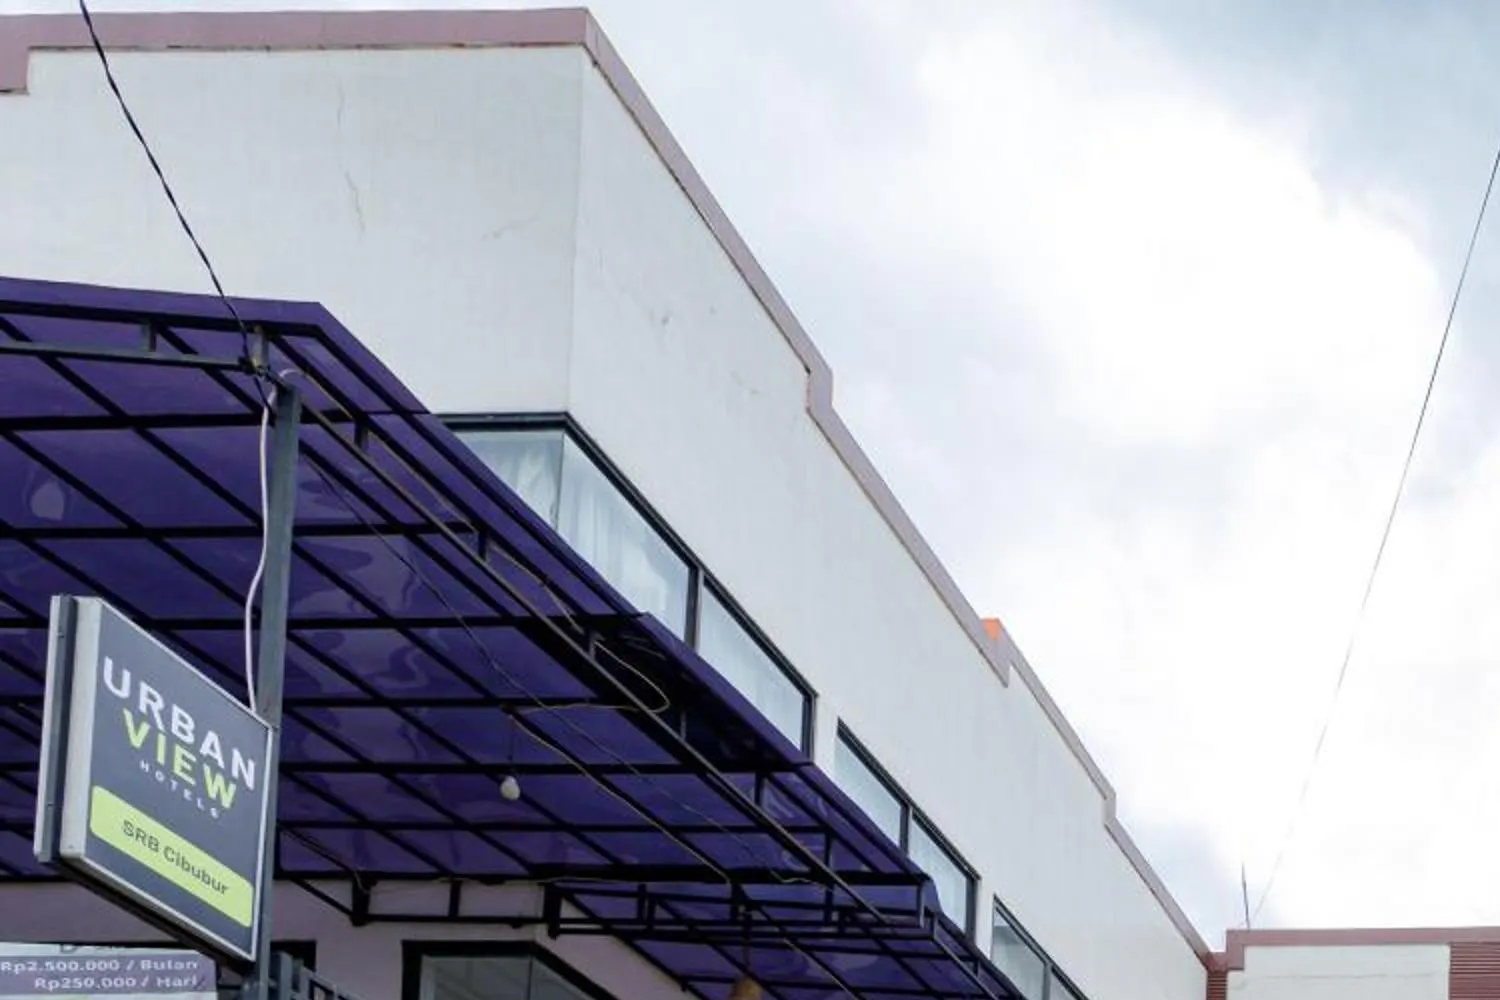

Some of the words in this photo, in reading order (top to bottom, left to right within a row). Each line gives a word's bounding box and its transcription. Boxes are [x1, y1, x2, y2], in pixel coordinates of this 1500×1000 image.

[103, 655, 257, 791] URBAN
[122, 707, 237, 809] VIEW
[140, 759, 219, 819] HOTELS
[122, 819, 160, 854] SRB
[163, 846, 230, 896] Cibubur
[34, 977, 136, 990] Rp250.000
[141, 960, 198, 971] Bulan
